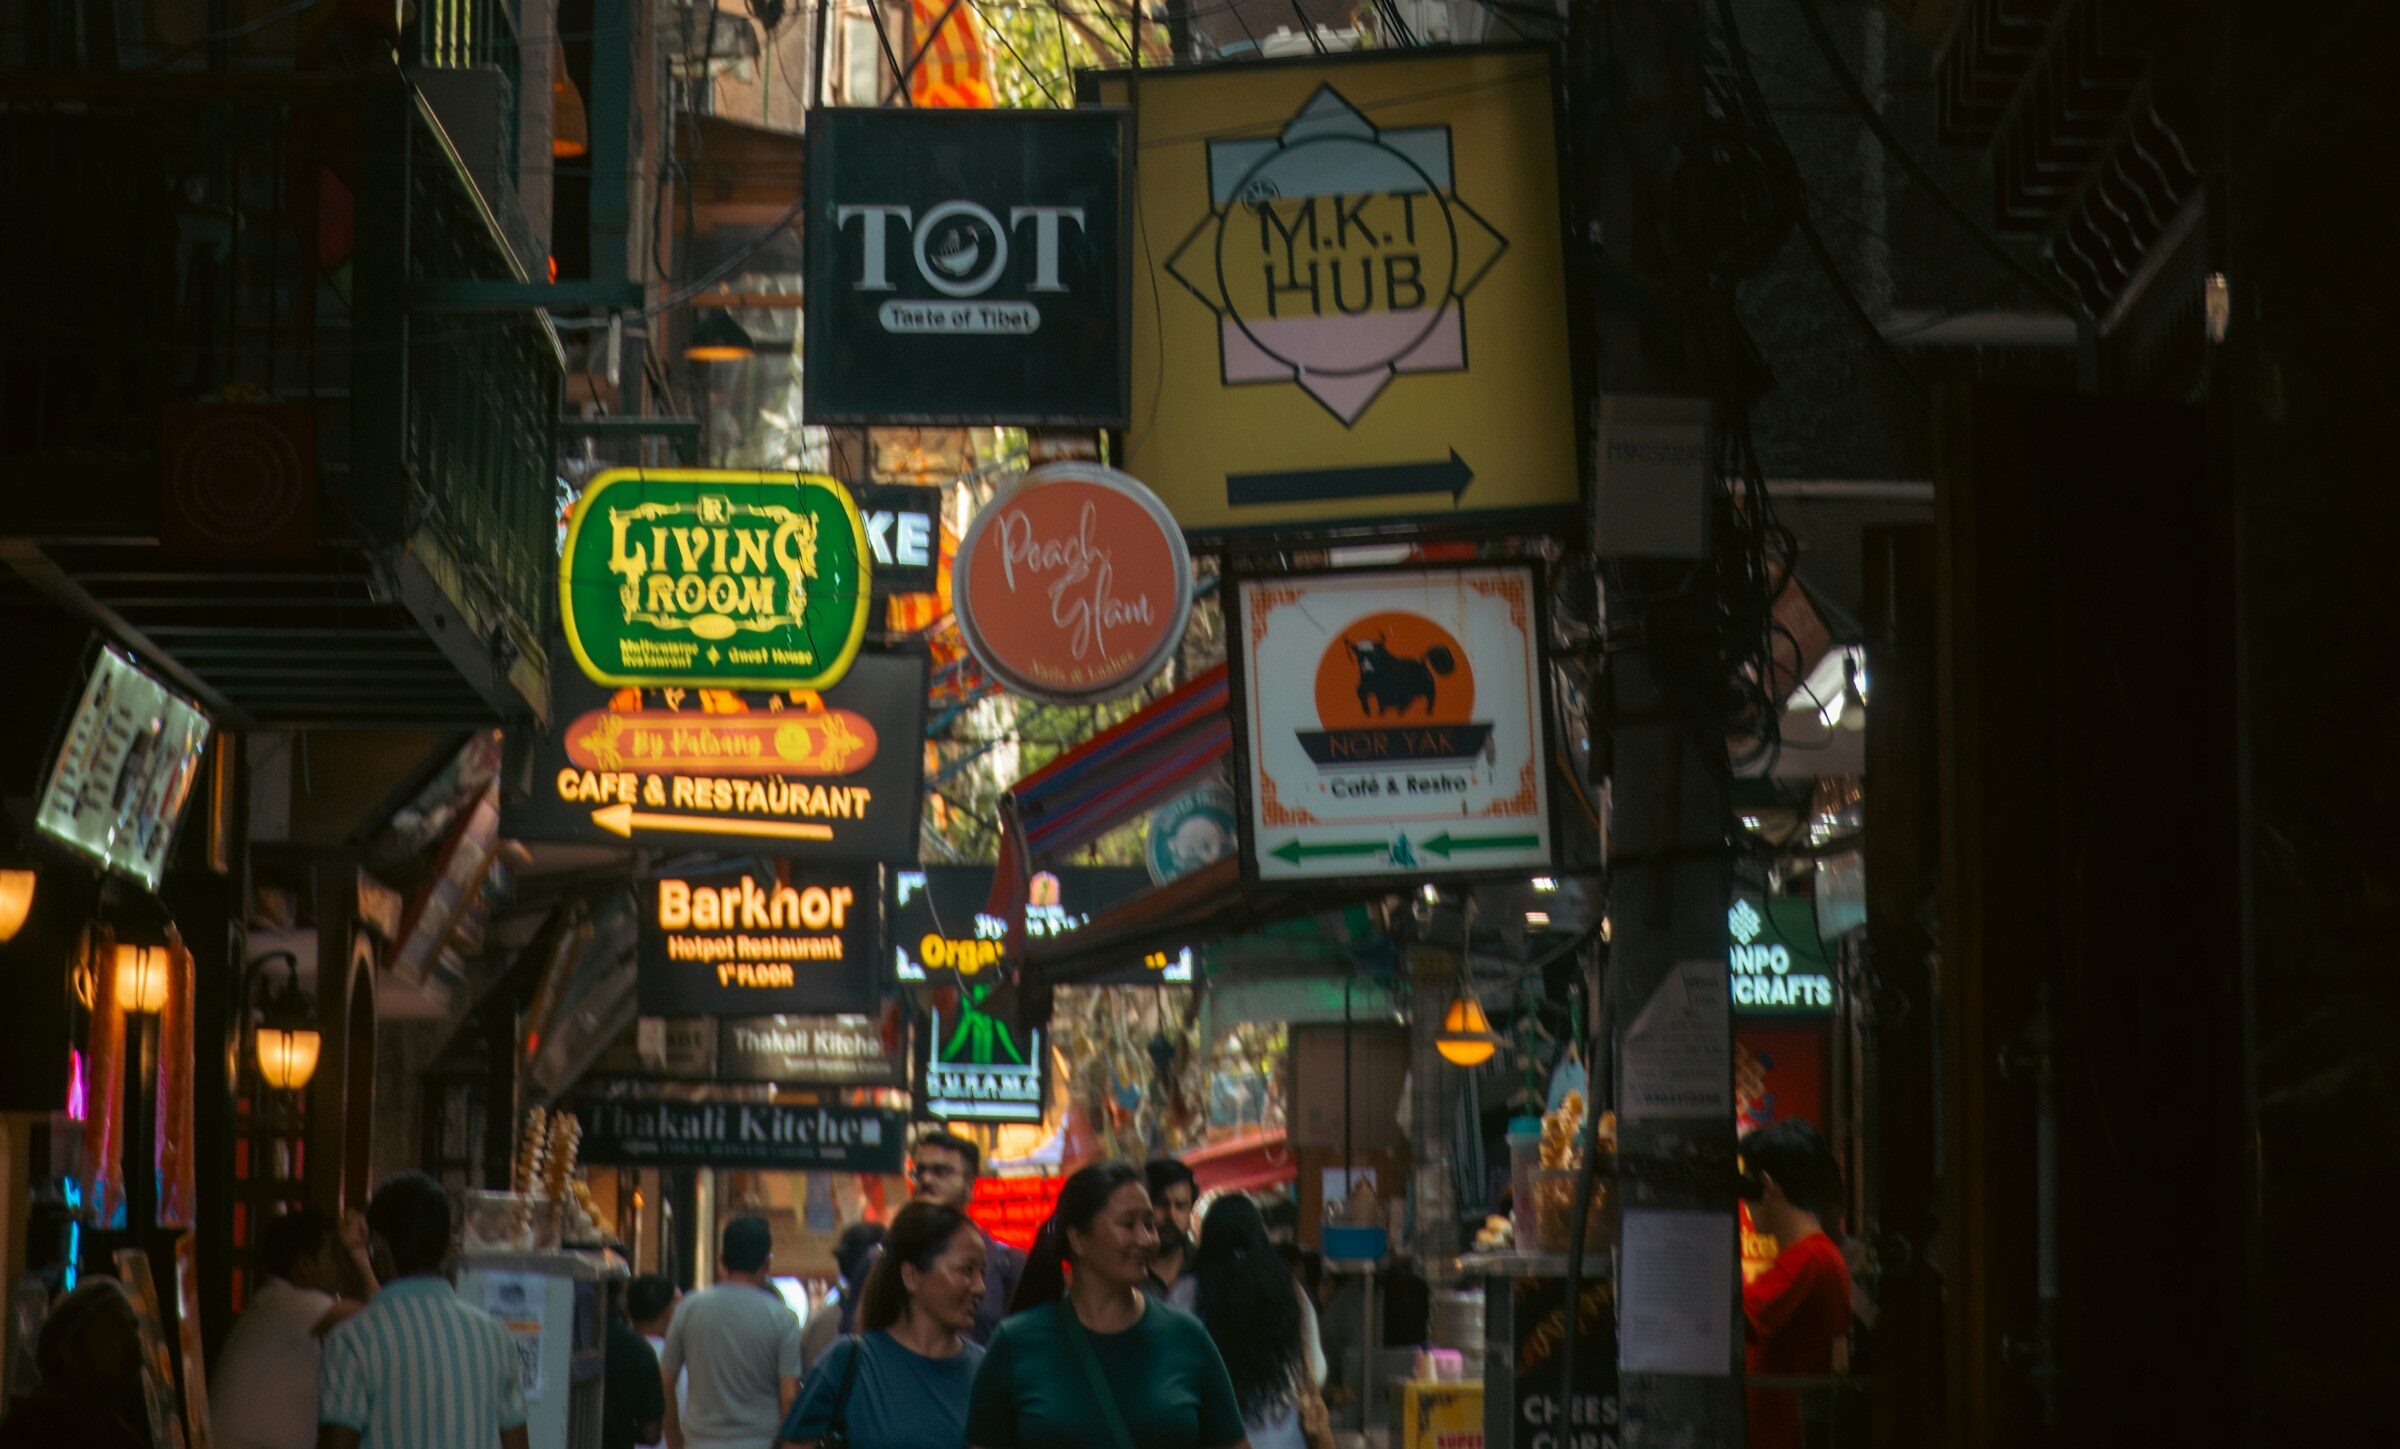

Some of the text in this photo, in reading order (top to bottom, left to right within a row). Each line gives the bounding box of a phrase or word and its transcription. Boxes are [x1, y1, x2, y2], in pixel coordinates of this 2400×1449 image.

[1257, 188, 1428, 256] M.K.T
[838, 199, 1085, 297] TOT
[1264, 253, 1426, 319] HUB
[891, 306, 1030, 328] Taste of Tibet
[994, 500, 1111, 593] Peach
[646, 573, 776, 615] ROOM
[1048, 559, 1154, 661] Glam
[1330, 730, 1454, 758] NOR YAK
[557, 767, 871, 819] CAFE & RESTAURANT
[1331, 771, 1468, 799] Café & Restro
[667, 933, 844, 963] Hotpot Restaurant
[737, 963, 795, 987] FLOOR
[734, 1026, 808, 1055] Thakali
[589, 1103, 726, 1142] Thakali
